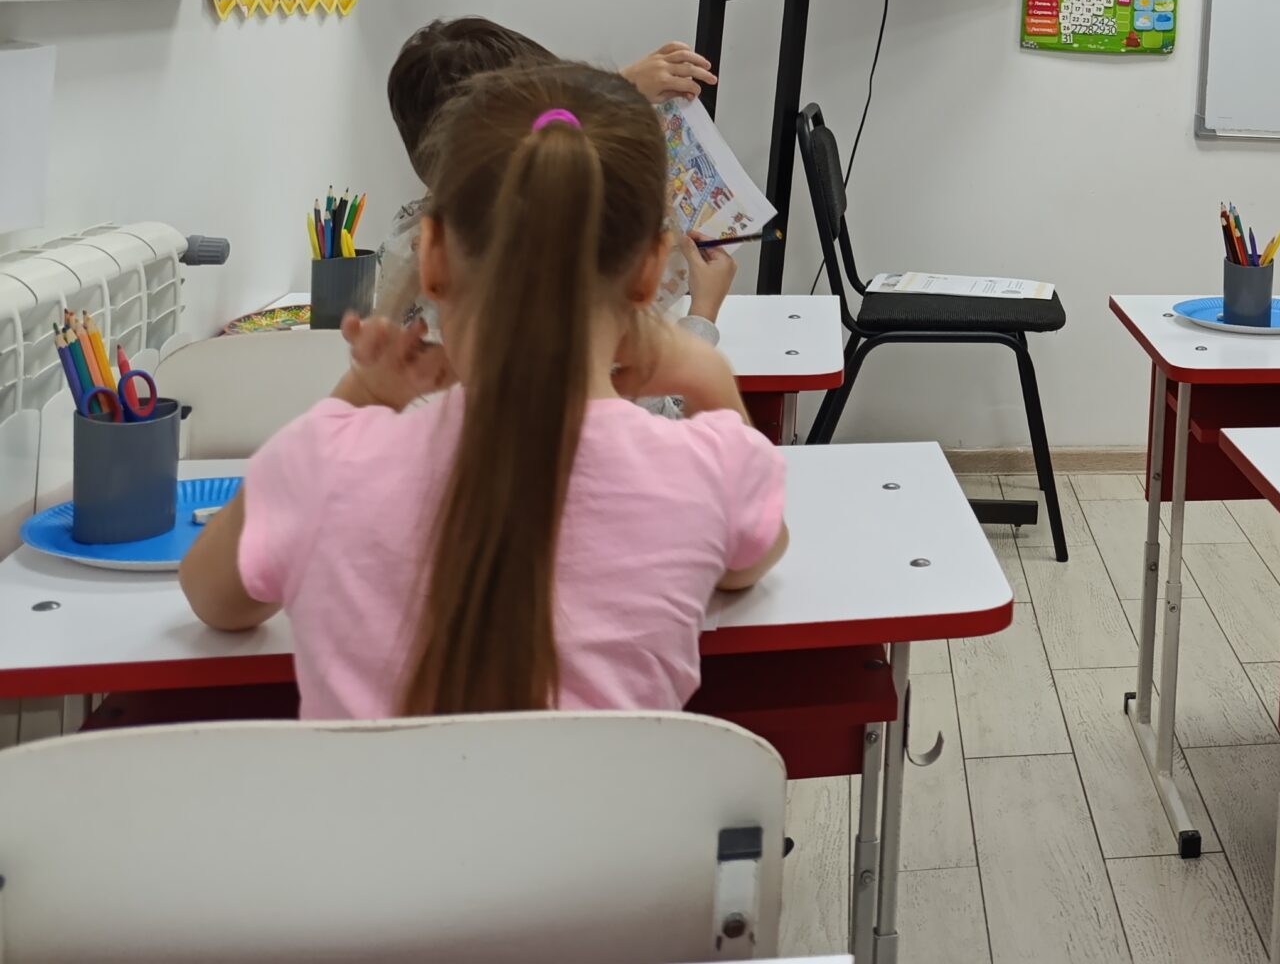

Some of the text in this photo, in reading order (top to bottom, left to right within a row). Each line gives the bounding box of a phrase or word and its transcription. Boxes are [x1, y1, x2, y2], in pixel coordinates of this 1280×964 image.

[1094, 17, 1104, 25] 24
[1071, 26, 1082, 34] 27
[1084, 26, 1094, 34] 28
[1094, 26, 1105, 34] 29
[1107, 26, 1116, 34] 30
[1063, 34, 1072, 42] 31
